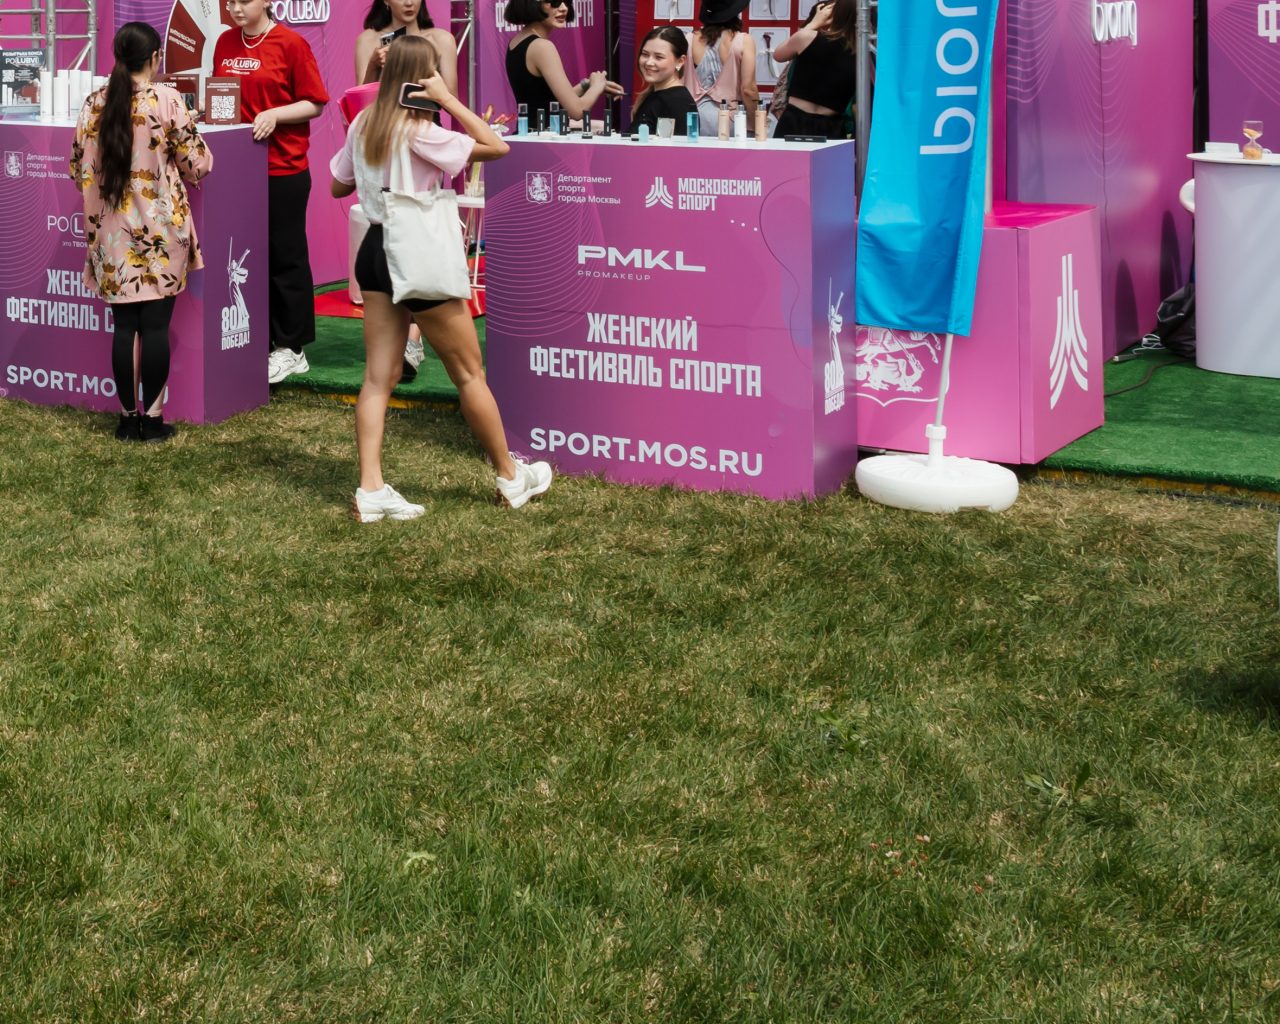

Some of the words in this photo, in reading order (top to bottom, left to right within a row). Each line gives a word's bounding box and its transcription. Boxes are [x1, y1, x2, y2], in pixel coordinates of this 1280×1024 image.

[289, 0, 326, 21] LUBVI
[557, 174, 612, 186] Департамент
[558, 184, 586, 195] спорта
[678, 176, 762, 197] МОСКОВСКИЙ
[558, 195, 587, 206] города
[588, 195, 621, 205] Москвы
[678, 194, 718, 211] СПОРТ
[47, 215, 69, 232] PO
[577, 244, 706, 273] PMKL
[577, 270, 651, 281] PROMAKEUP
[6, 296, 99, 331] ФЕСТИВАЛЬ
[222, 330, 250, 350] ПОБЕДА!
[587, 311, 698, 352] ЖЕНСКИЙ
[529, 346, 662, 387] ФЕСТИВАЛЬ
[669, 358, 762, 397] СПОРТА
[529, 427, 763, 477] SPORT.MOS.RU
